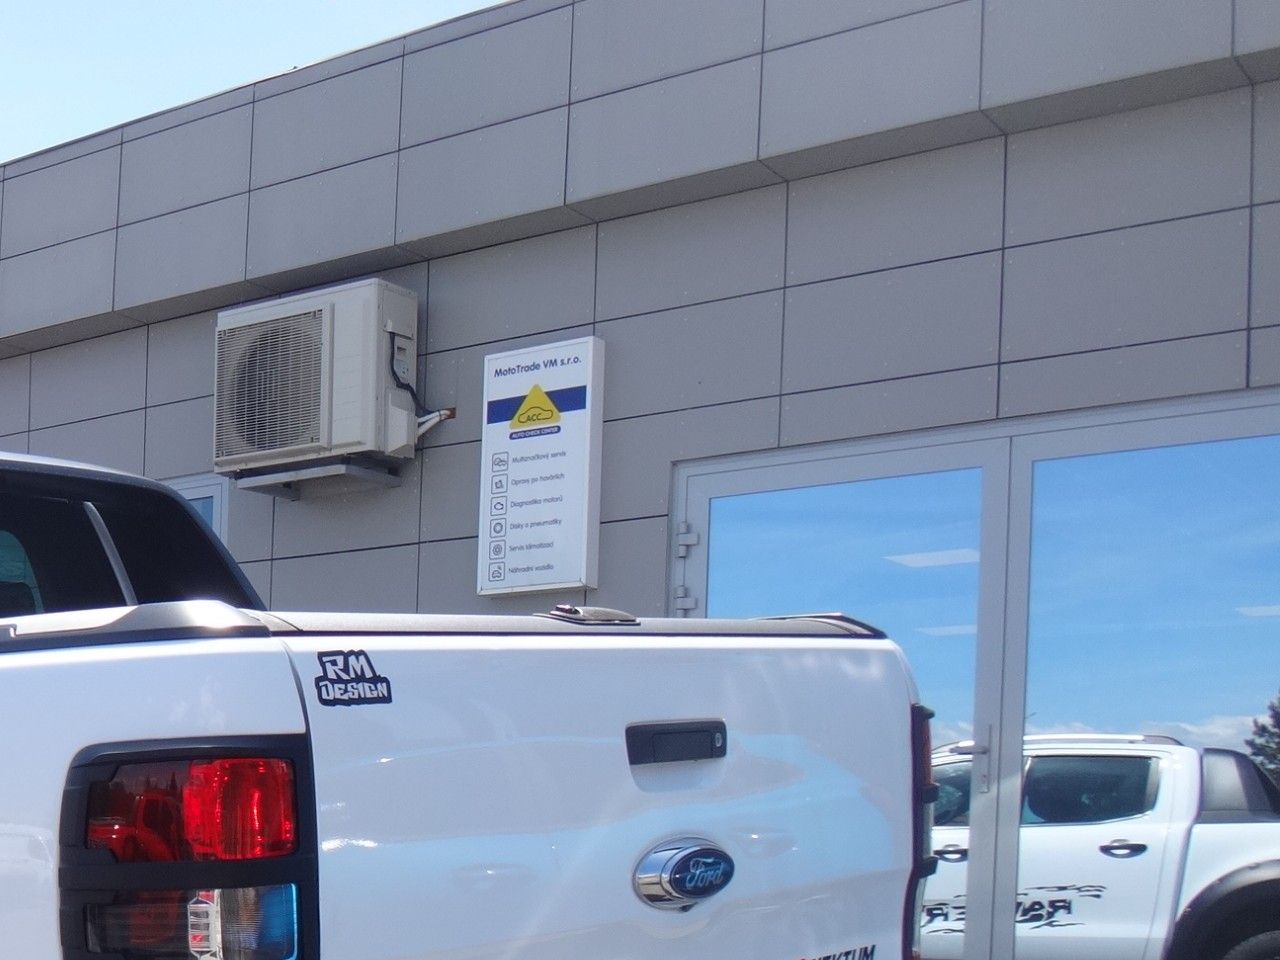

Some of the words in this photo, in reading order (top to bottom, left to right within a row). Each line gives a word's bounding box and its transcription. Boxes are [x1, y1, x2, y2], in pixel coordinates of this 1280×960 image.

[494, 362, 540, 377] MotoTrade
[543, 359, 558, 368] VM
[560, 356, 581, 366] s.r.o.
[526, 412, 543, 422] ACC
[511, 500, 541, 508] Diagnostika
[321, 654, 374, 680] RM
[319, 680, 388, 701] DESIGN
[685, 857, 726, 887] Ford
